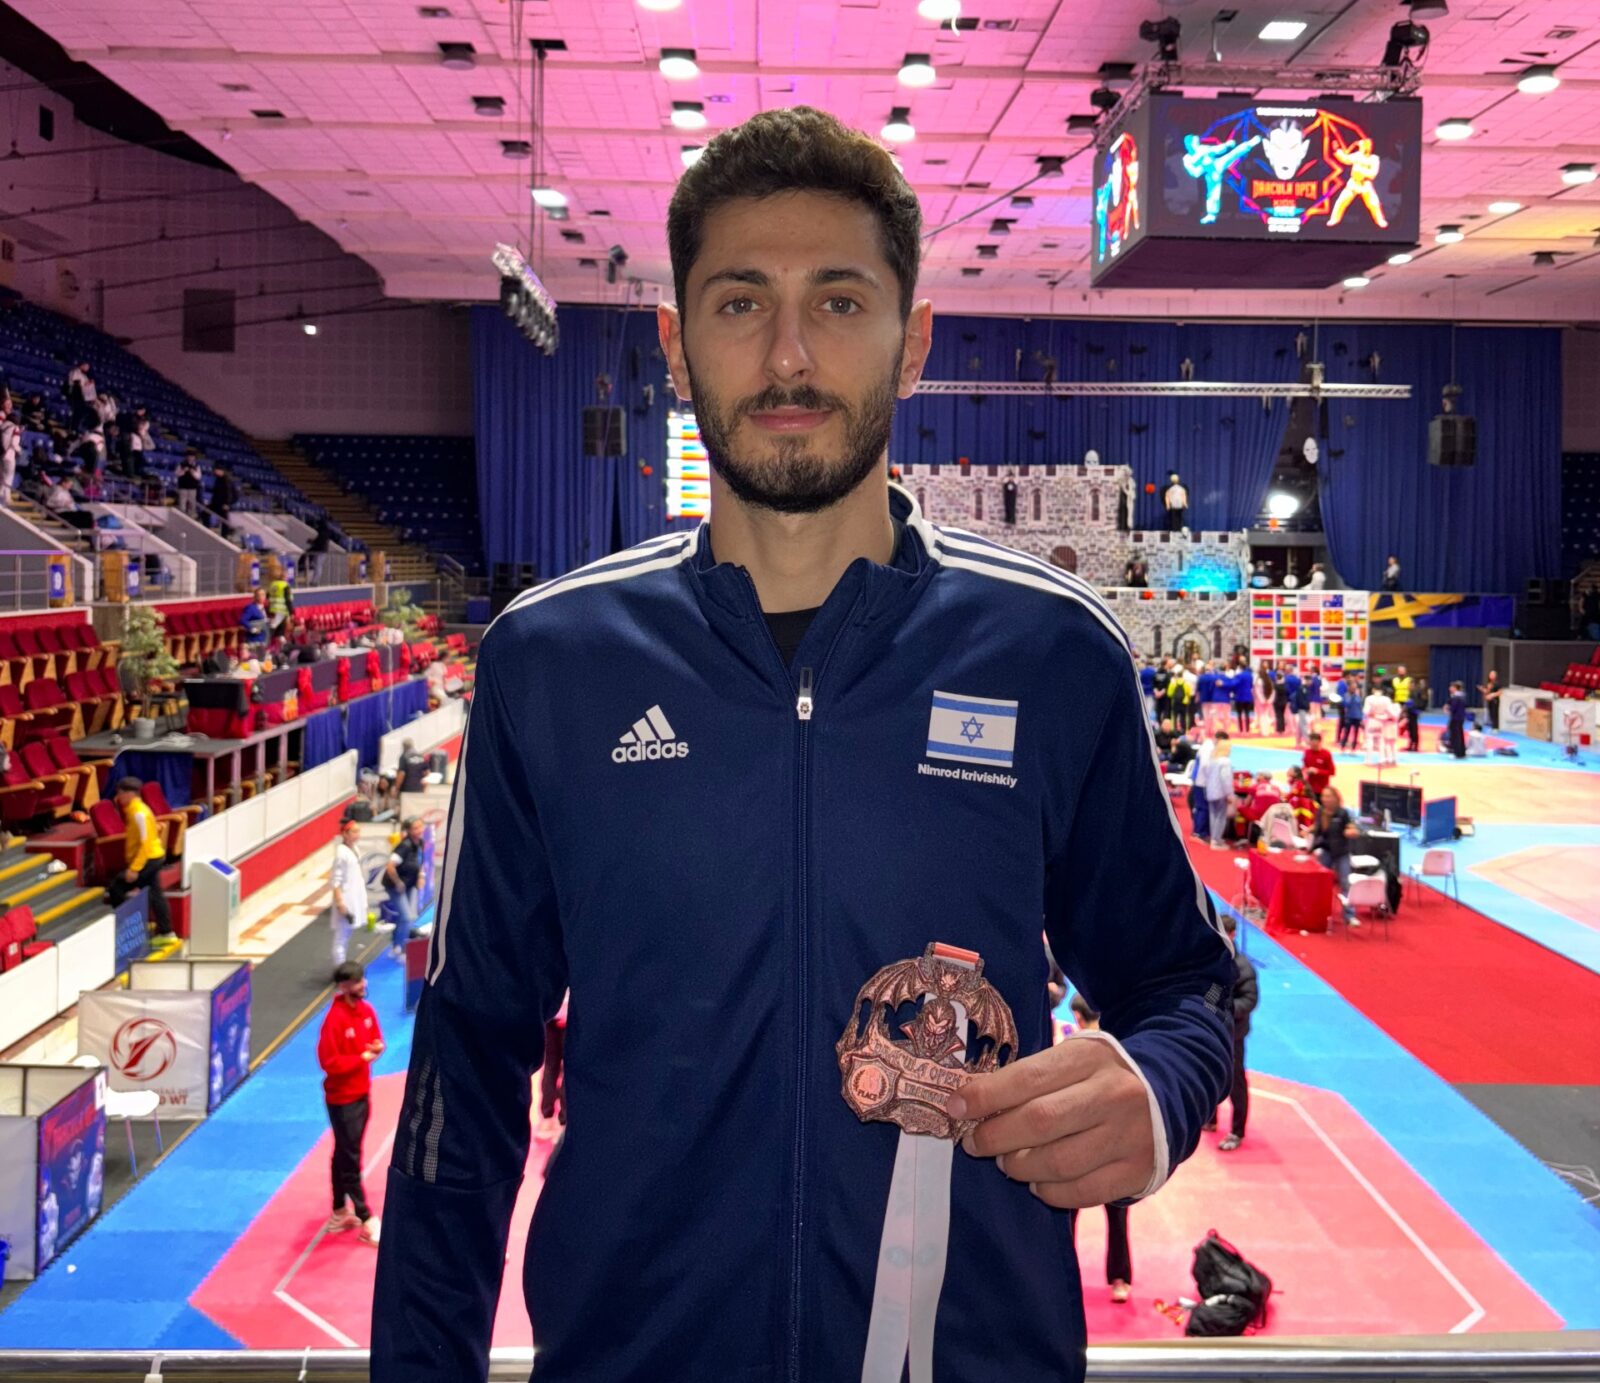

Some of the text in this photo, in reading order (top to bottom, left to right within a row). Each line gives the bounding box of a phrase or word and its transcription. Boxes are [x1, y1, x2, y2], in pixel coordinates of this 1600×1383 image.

[611, 739, 690, 763] adidas
[918, 763, 1018, 788] Nimrod krivishkiy
